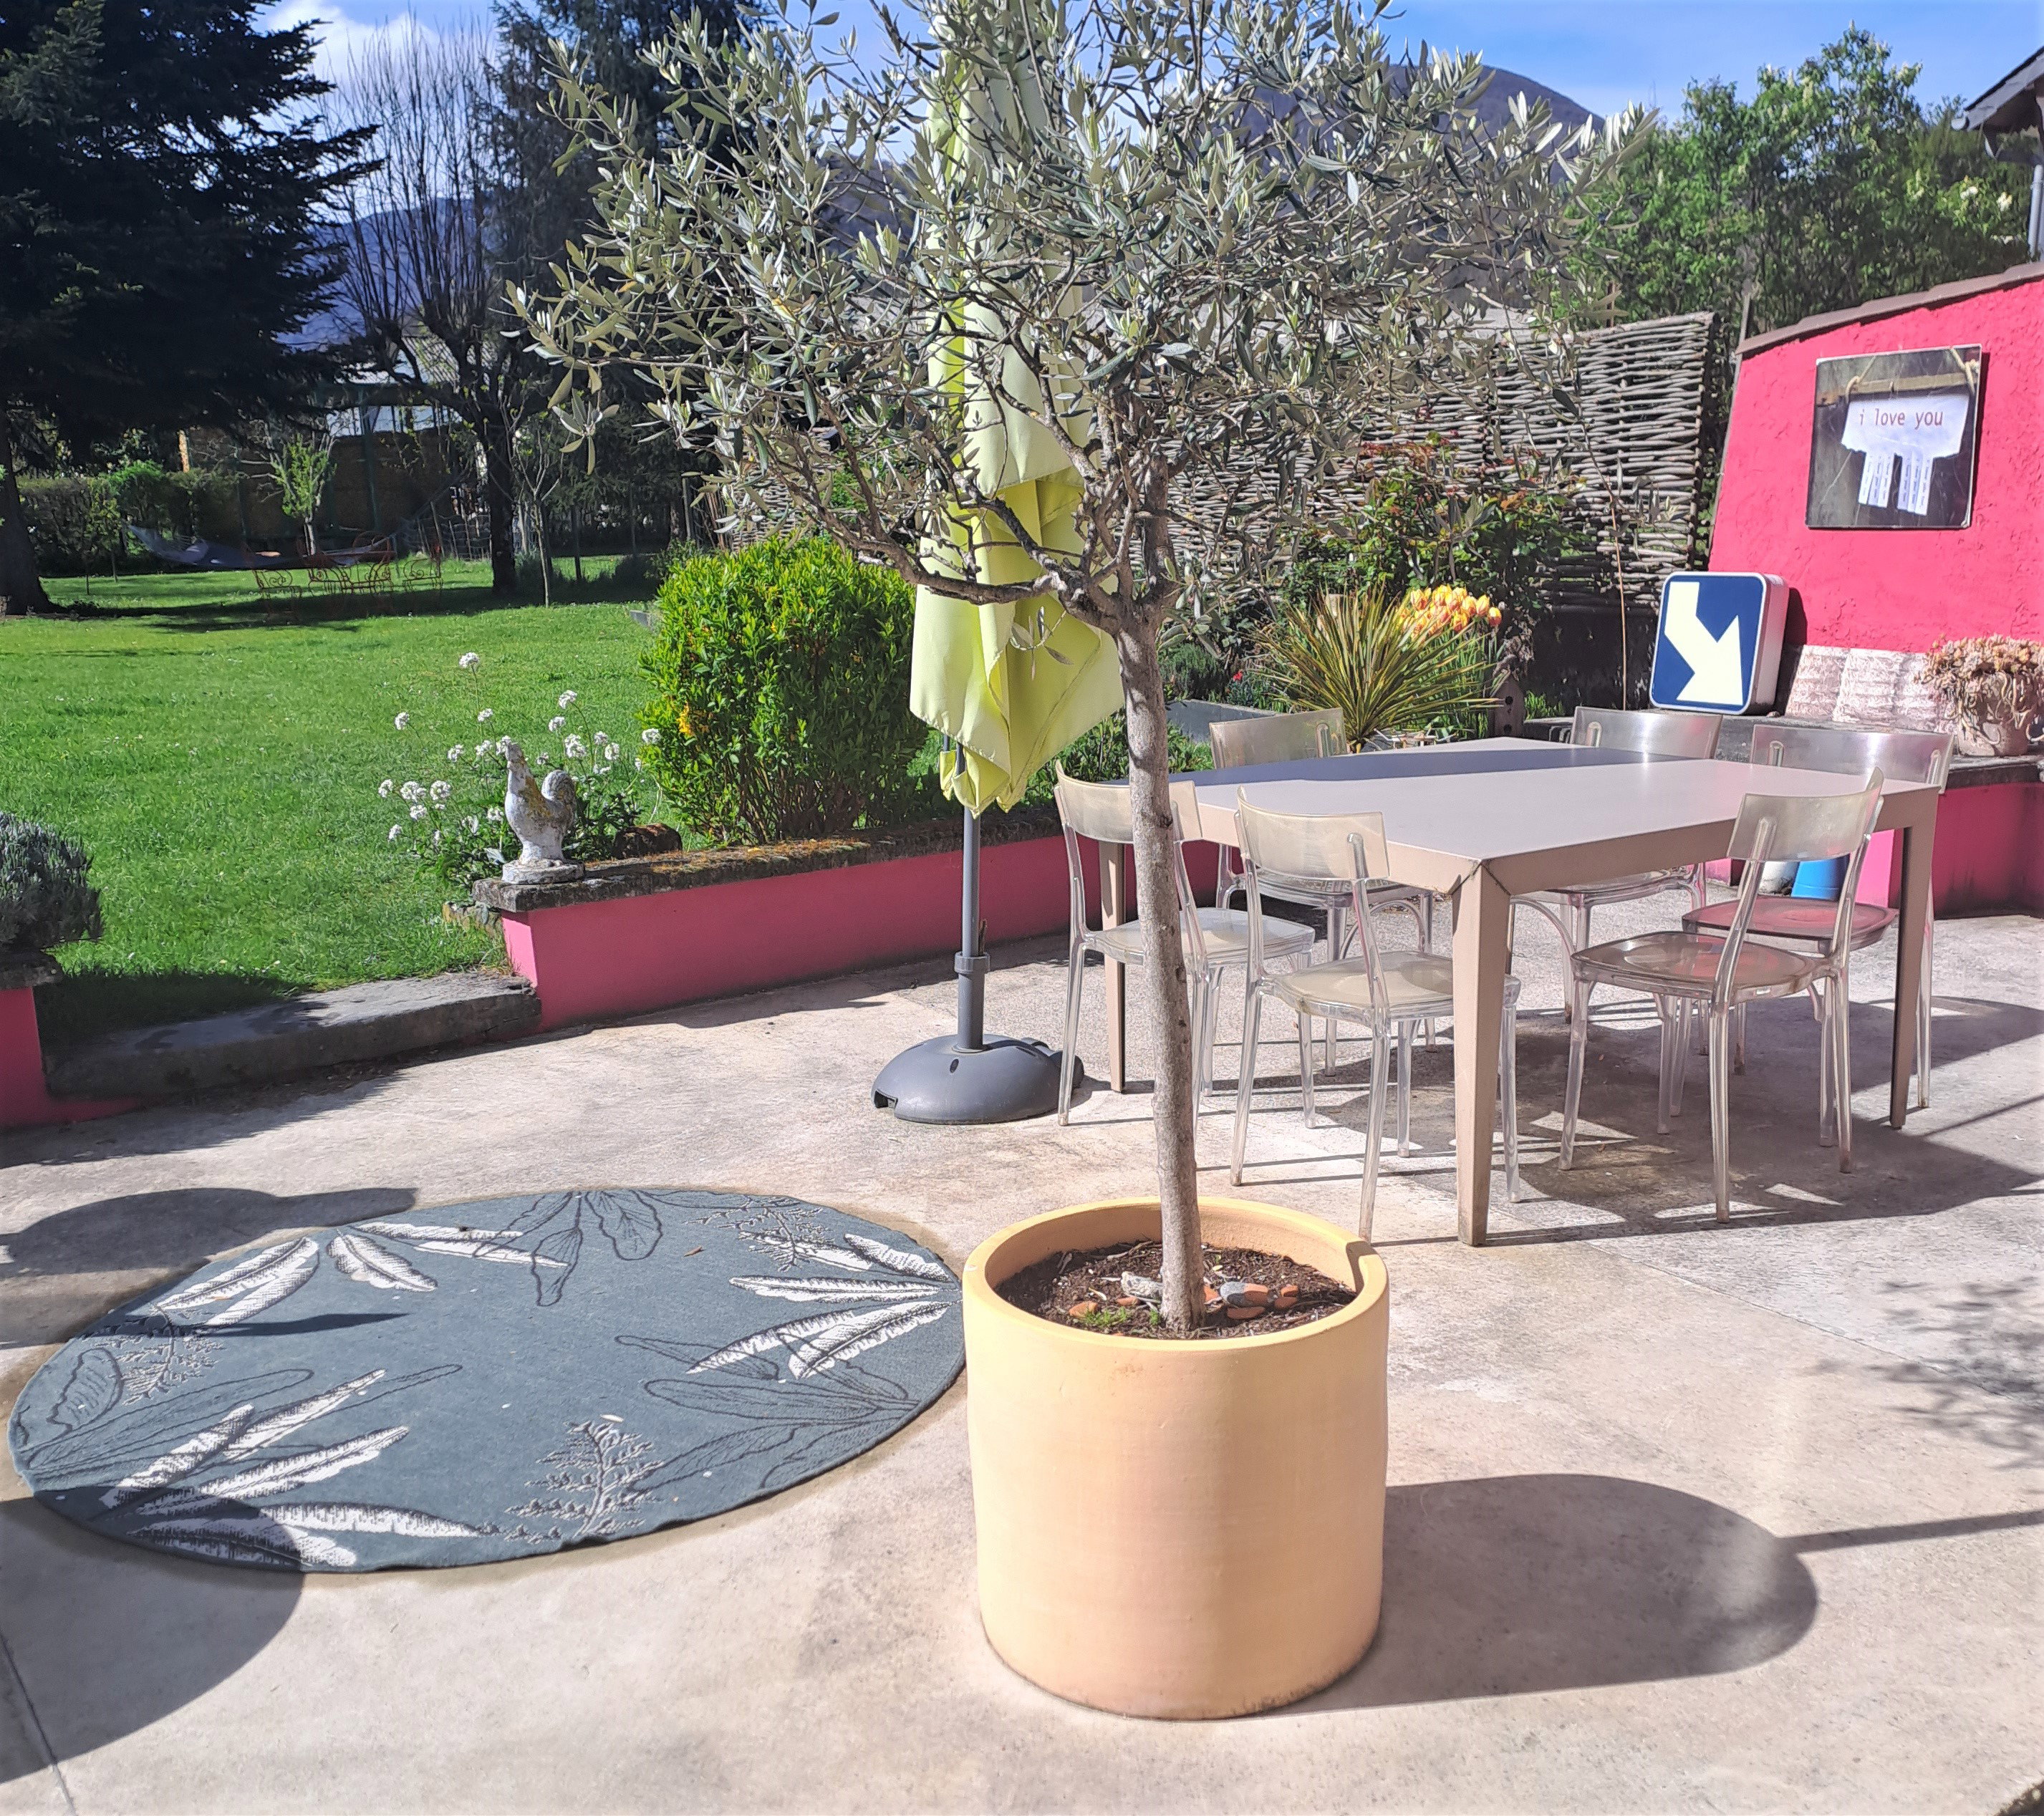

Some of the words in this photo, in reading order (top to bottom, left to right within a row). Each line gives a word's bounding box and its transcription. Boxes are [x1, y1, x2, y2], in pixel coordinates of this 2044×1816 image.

[1859, 408, 1865, 425] i
[1875, 407, 1906, 426] love
[1914, 411, 1944, 430] you
